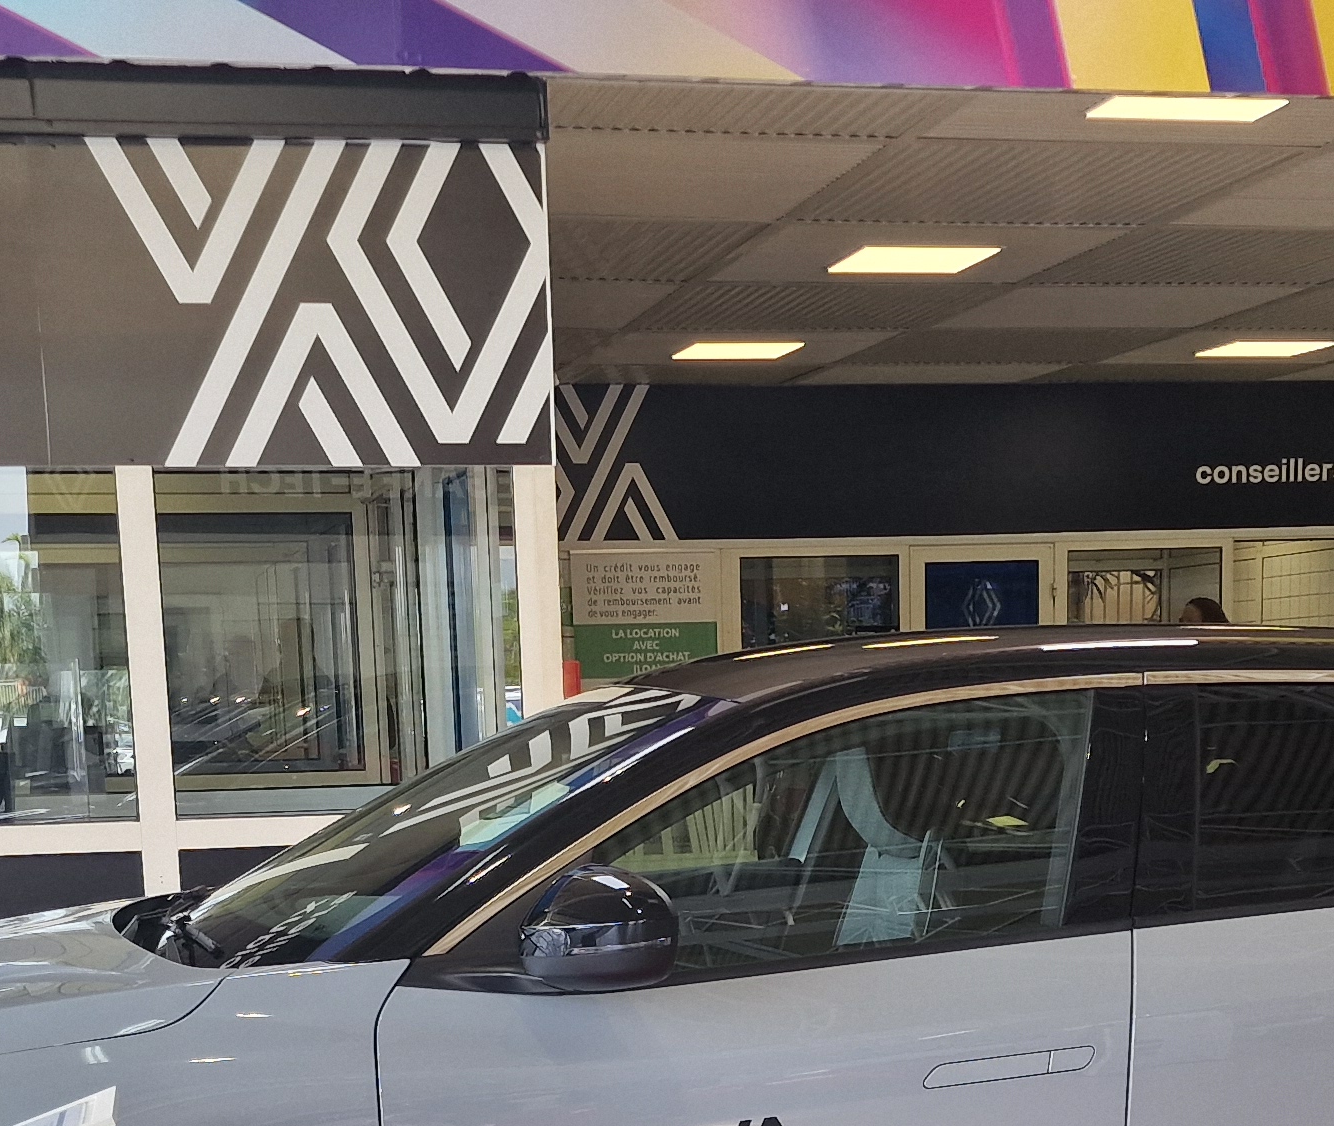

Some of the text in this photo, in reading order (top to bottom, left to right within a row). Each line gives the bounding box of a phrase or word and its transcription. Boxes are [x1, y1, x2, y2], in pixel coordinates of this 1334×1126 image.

[586, 562, 701, 573] Un crédit vous engage
[586, 575, 596, 584] et
[601, 574, 621, 584] doit
[625, 574, 644, 583] être
[587, 584, 701, 596] Vérifiez vos capacités
[587, 596, 701, 607] de remboursement avant
[598, 610, 619, 618] vous
[612, 628, 680, 638] LA LOCATION
[633, 640, 660, 650] AVEC
[604, 652, 690, 662] OPTION D'ACHAT
